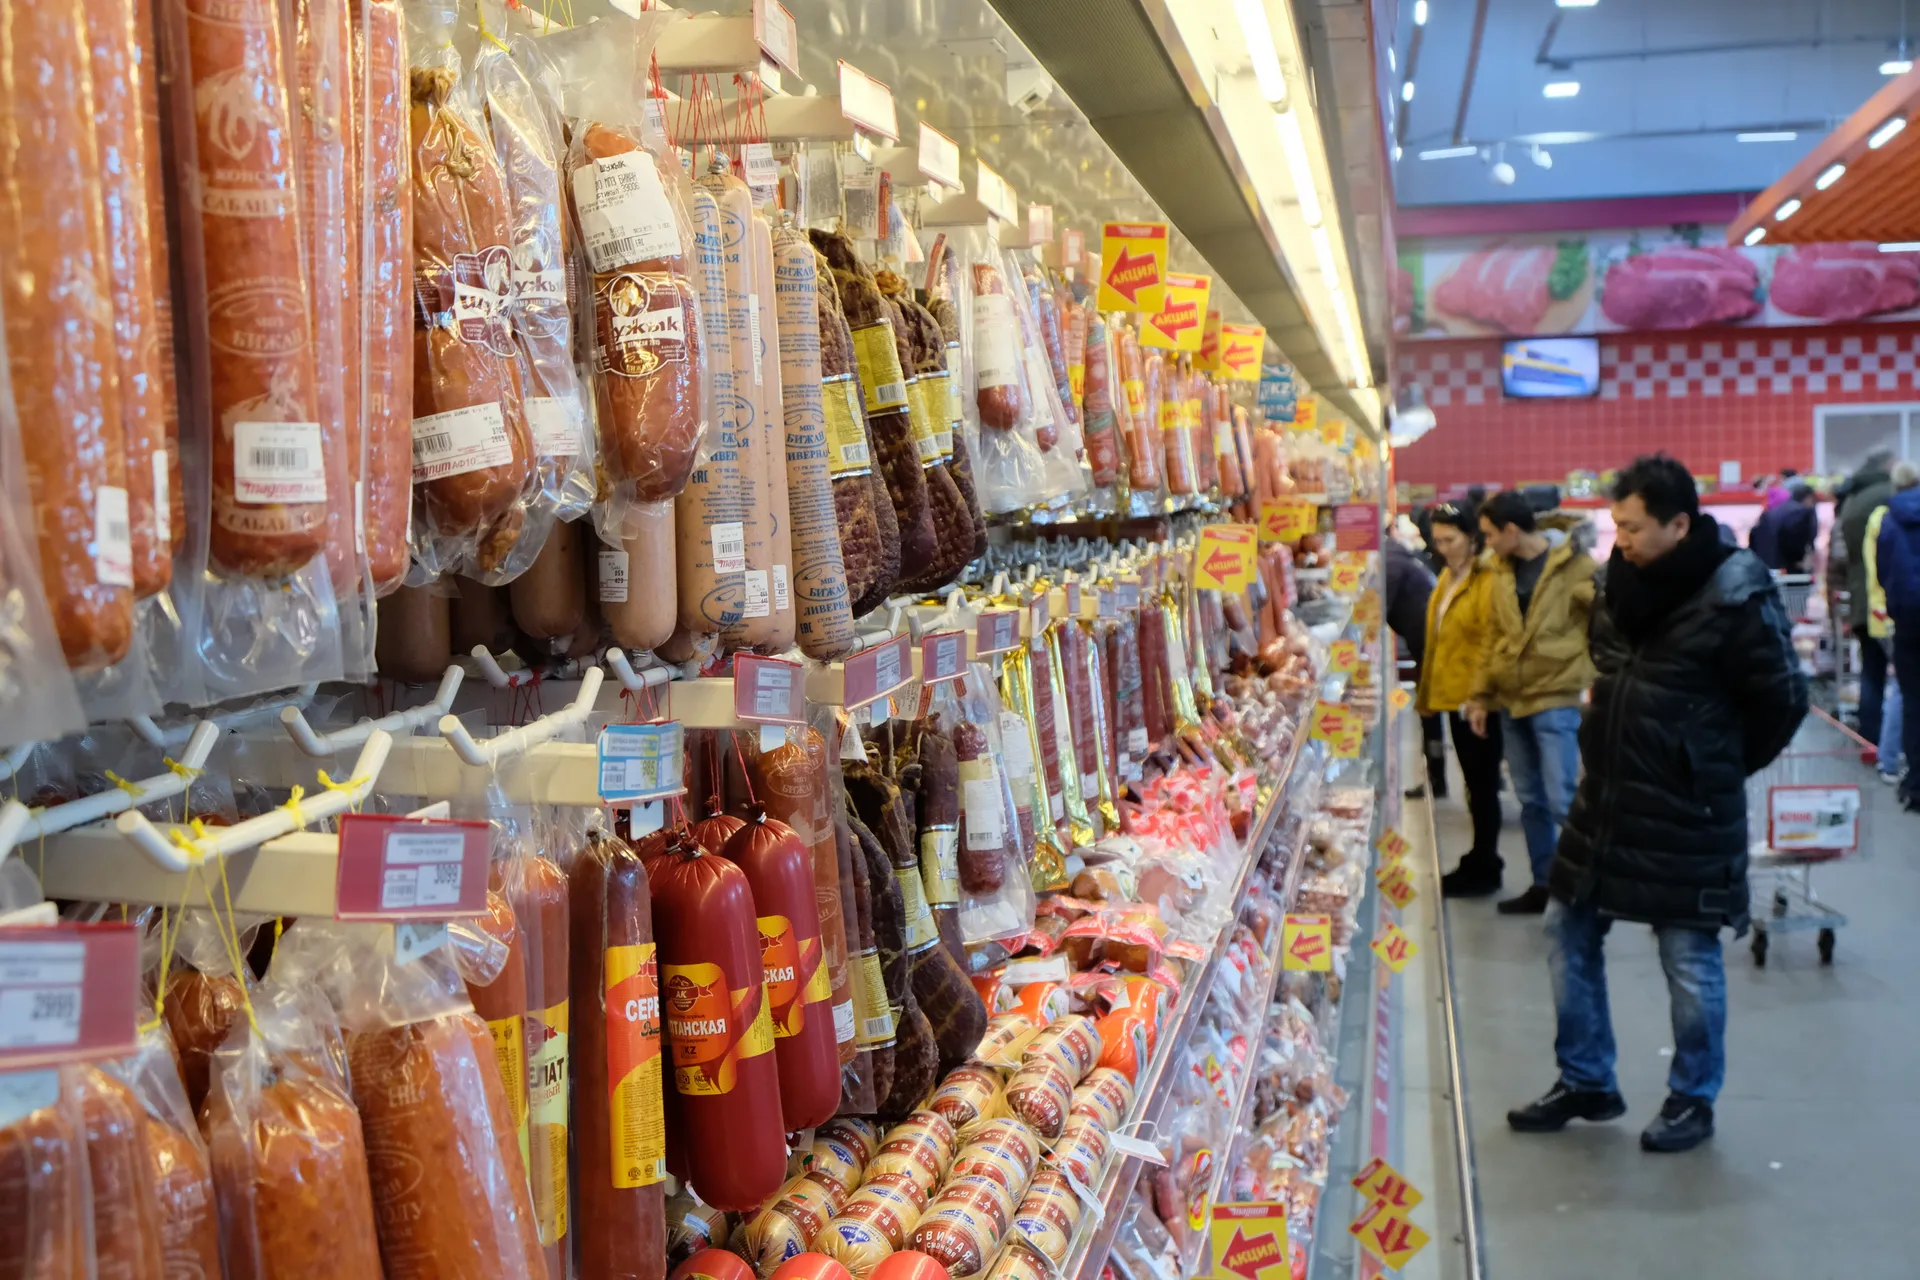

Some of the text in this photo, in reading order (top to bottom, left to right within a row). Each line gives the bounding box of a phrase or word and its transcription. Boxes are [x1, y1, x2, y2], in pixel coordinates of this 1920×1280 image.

[776, 266, 814, 277] БИЖАН
[1112, 263, 1156, 286] АКЦИЯ
[1155, 309, 1197, 326] АКЦИЯ
[787, 431, 825, 444] БИЖАН
[452, 457, 476, 469] АФ10
[1207, 558, 1242, 573] АКЦИЯ
[809, 581, 846, 597] БИЖАН
[915, 1230, 973, 1262] СВИНАЯ
[1228, 1241, 1278, 1269] АКЦИЯ
